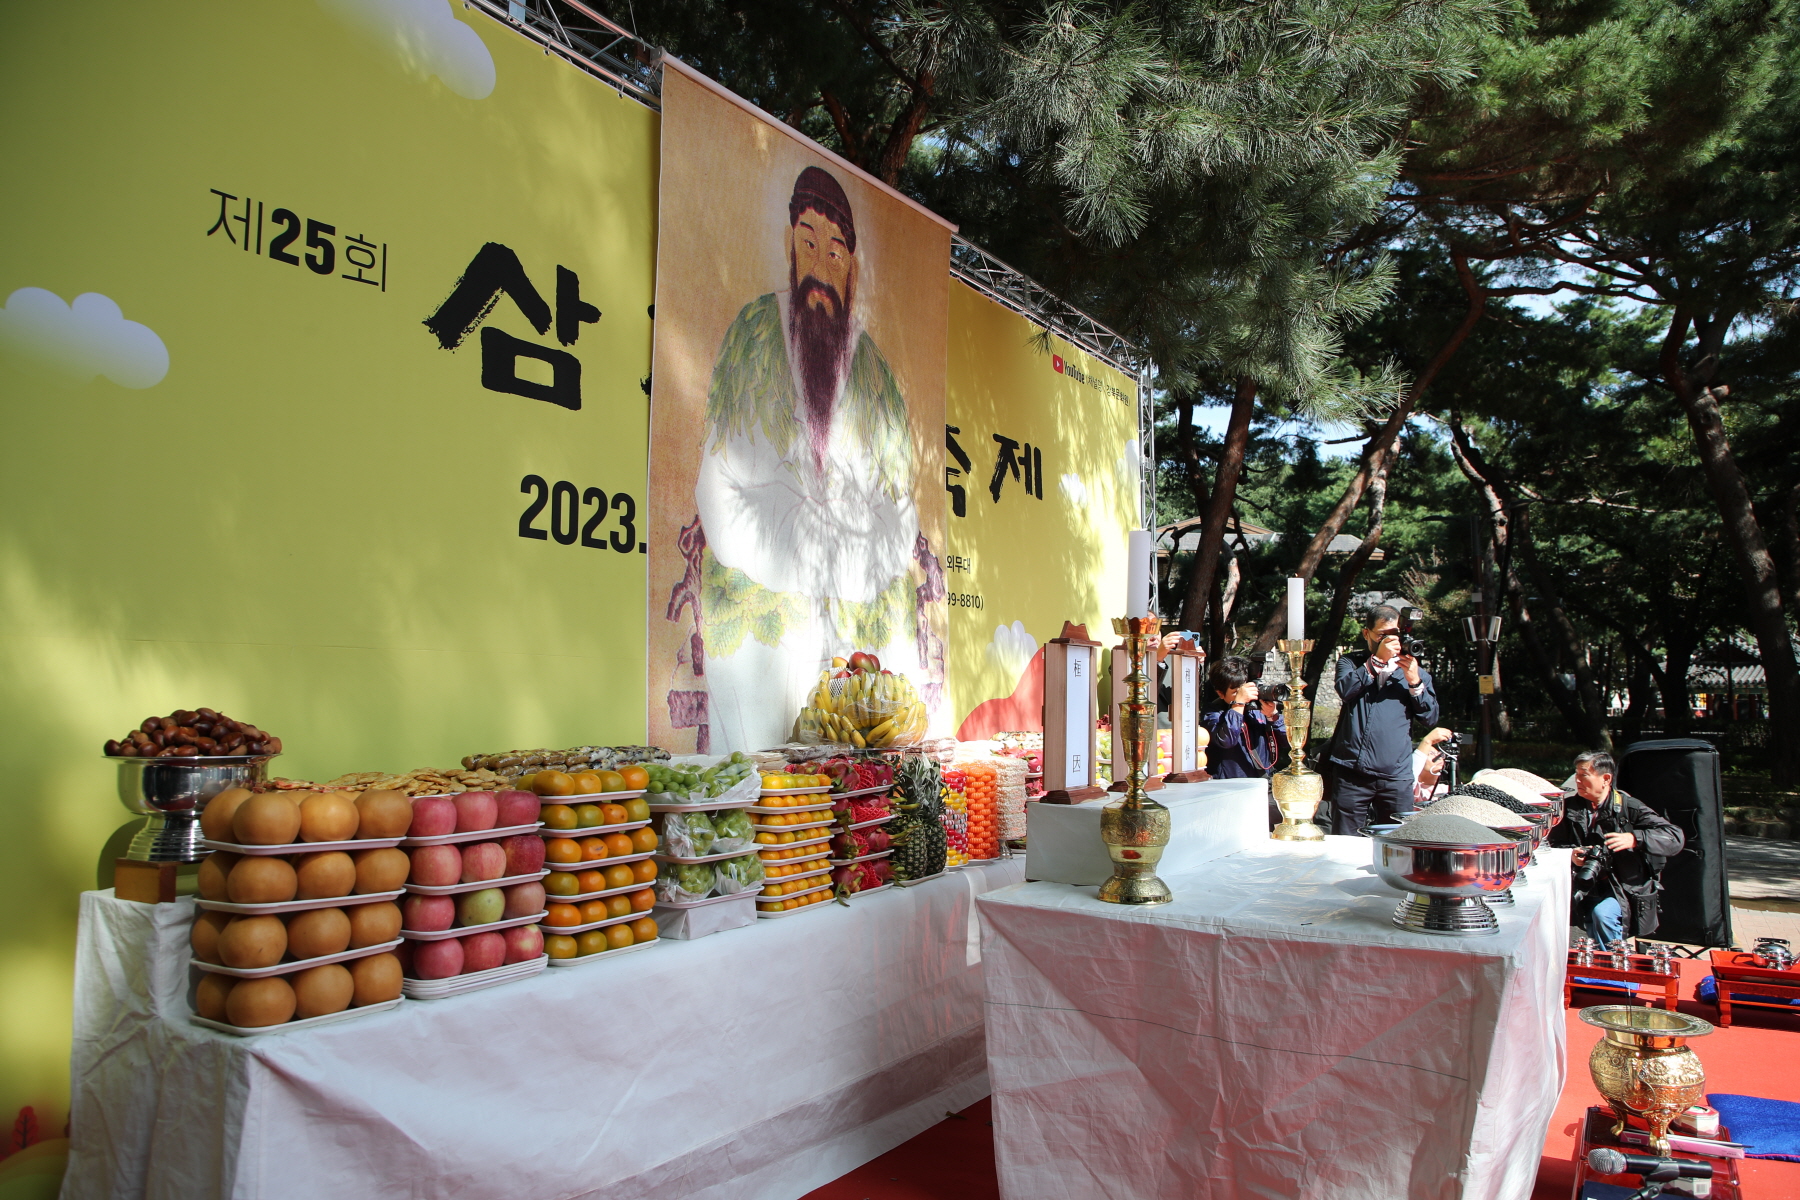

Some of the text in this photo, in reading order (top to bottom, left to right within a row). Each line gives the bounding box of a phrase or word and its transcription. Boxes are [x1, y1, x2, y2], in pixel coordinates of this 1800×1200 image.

[207, 188, 387, 292] 제25회
[422, 241, 655, 411] 삼
[1064, 361, 1085, 384] YouTube
[946, 554, 971, 574] 외무대
